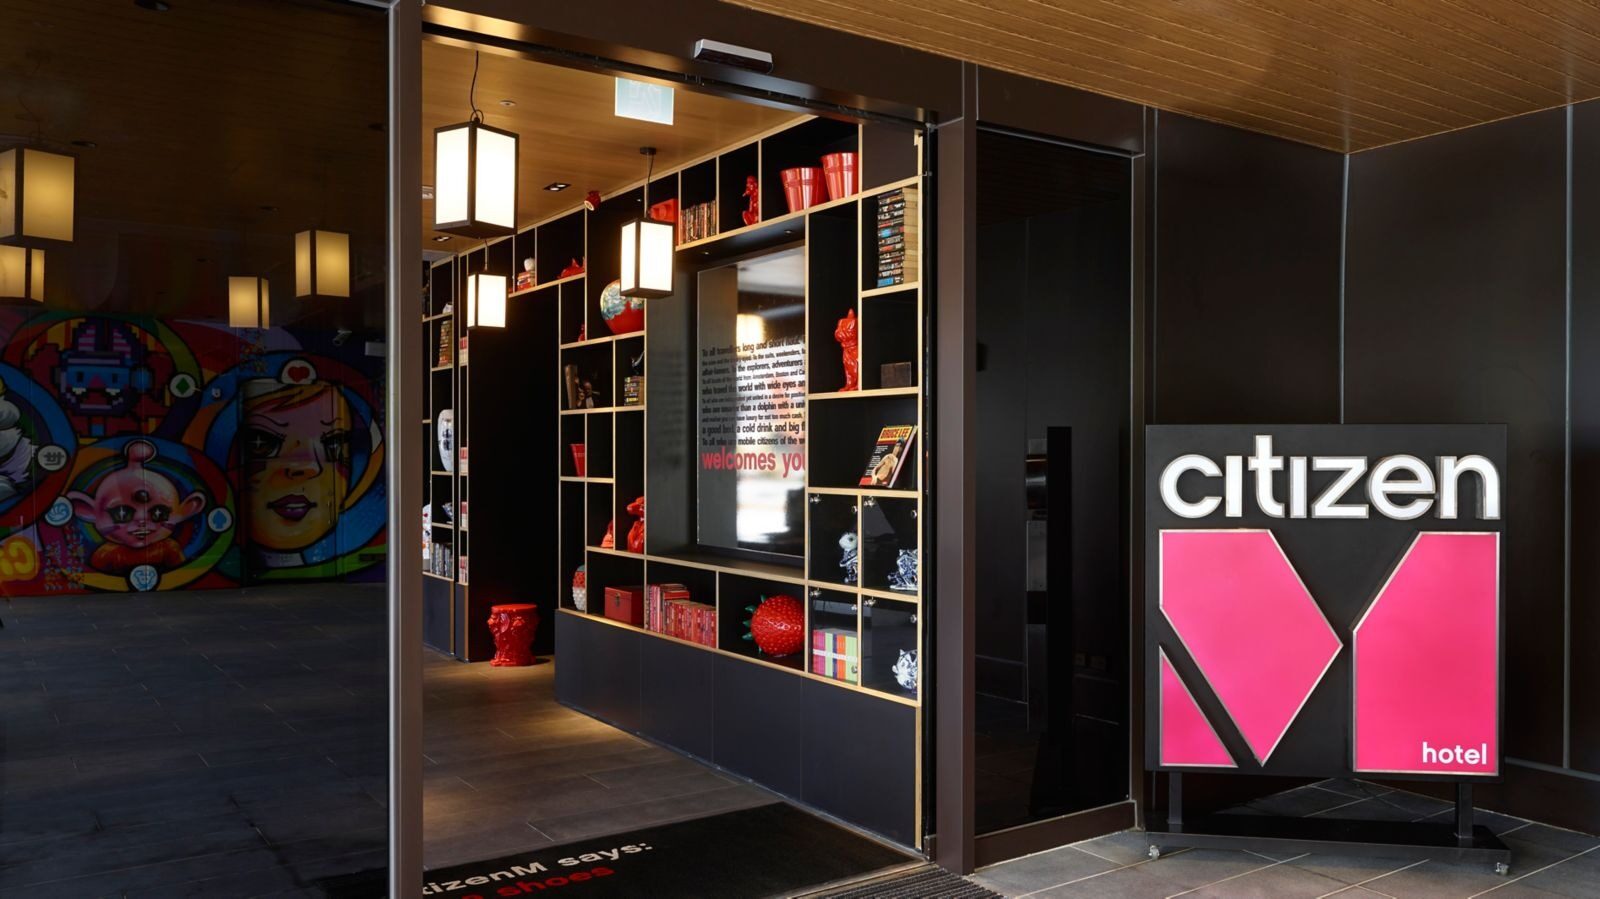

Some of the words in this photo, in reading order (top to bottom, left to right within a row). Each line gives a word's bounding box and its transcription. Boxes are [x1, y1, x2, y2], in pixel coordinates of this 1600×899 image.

[742, 343, 754, 353] long
[756, 340, 767, 349] and
[747, 362, 770, 372] explorers,
[772, 359, 803, 368] adventurers
[738, 383, 753, 392] world
[754, 382, 766, 391] with
[767, 380, 781, 390] wide
[782, 380, 796, 390] eyes
[757, 402, 776, 412] dolphin
[778, 401, 789, 409] with
[746, 414, 757, 422] luxury
[707, 424, 721, 437] good
[742, 423, 755, 433] cold
[757, 422, 773, 433] drink
[774, 421, 787, 432] and
[789, 421, 800, 434] big
[738, 436, 755, 445] mobile
[757, 436, 778, 445] citizens
[780, 436, 786, 444] of
[787, 436, 797, 444] the
[702, 446, 776, 471] welcomes
[1159, 435, 1501, 520] citizen
[1422, 741, 1488, 765] hotel
[556, 841, 653, 868] says:
[495, 865, 616, 897] shoes
